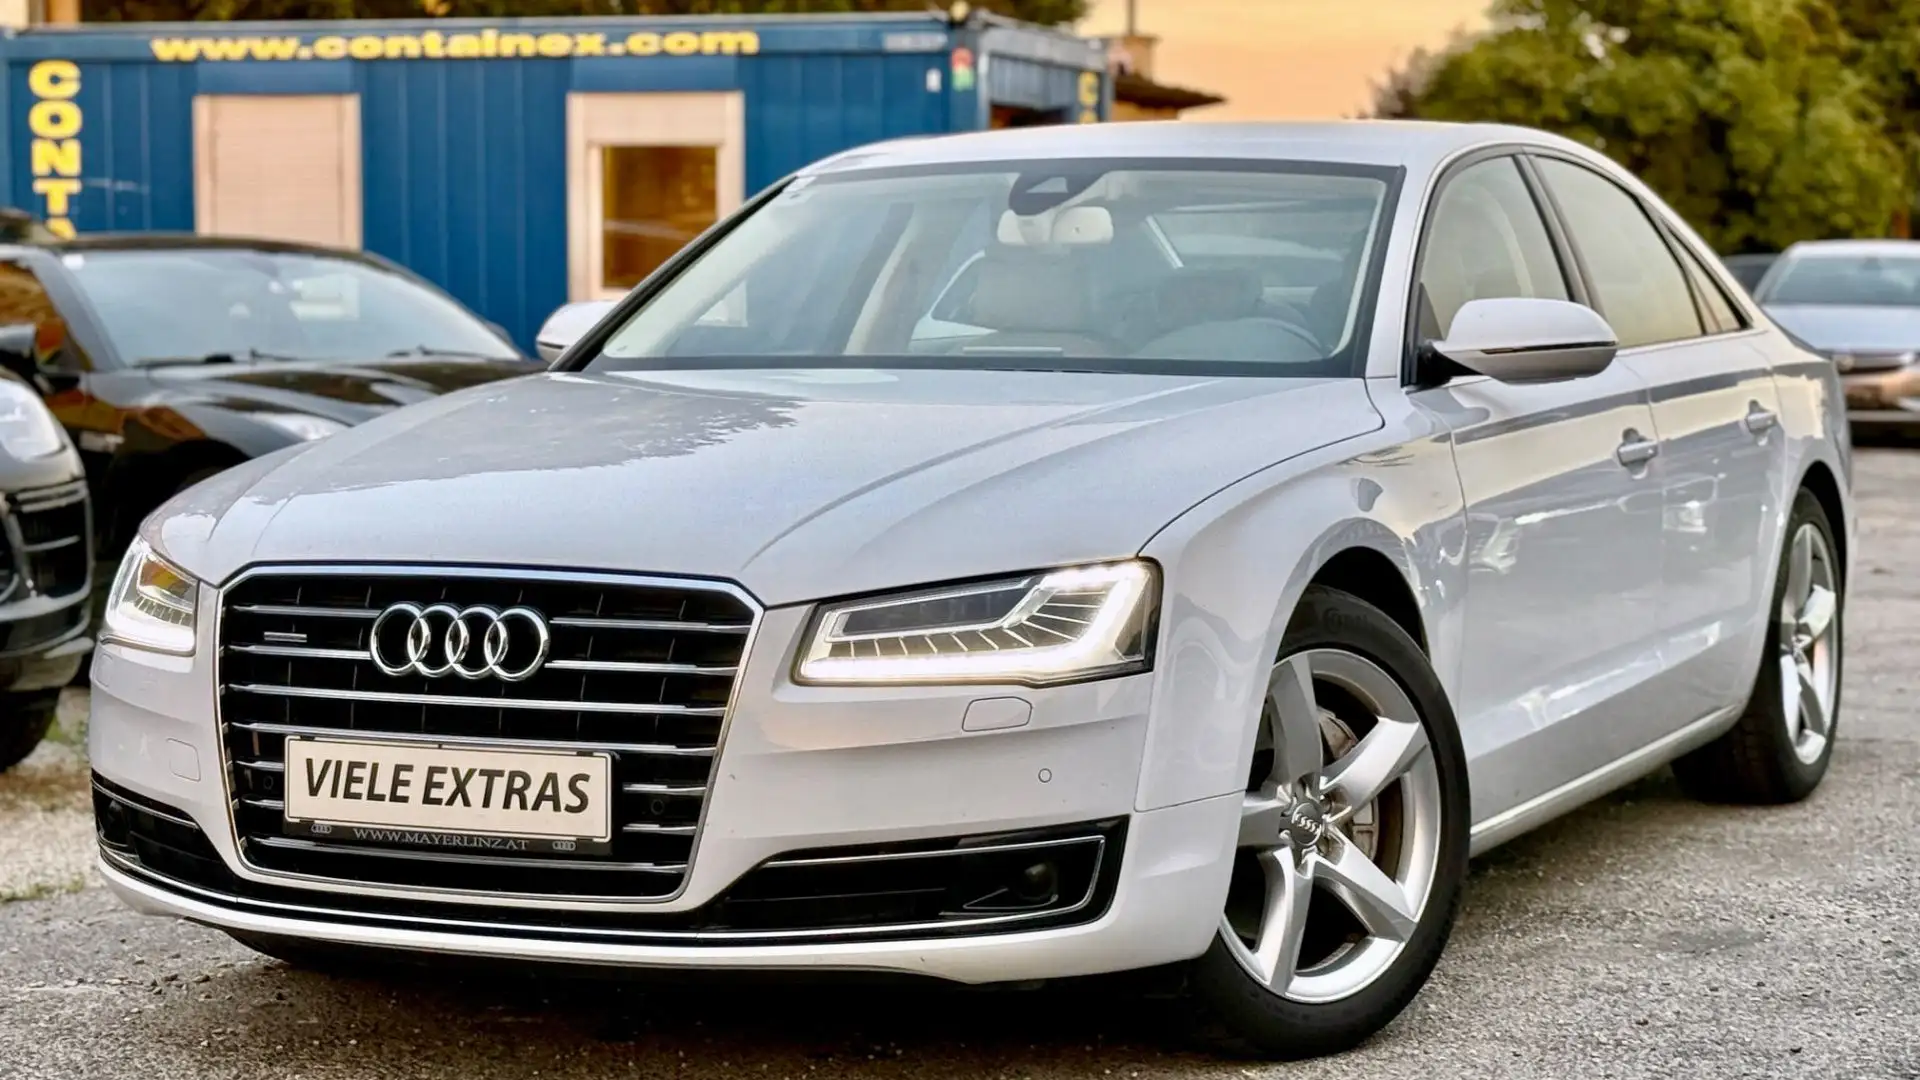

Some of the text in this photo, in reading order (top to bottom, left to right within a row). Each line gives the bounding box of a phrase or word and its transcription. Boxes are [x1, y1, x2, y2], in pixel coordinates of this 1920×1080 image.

[151, 29, 760, 62] www.containex.com
[305, 758, 591, 814] VIELE EXTRAS
[353, 827, 530, 850] WWW.MAYERLINZ.AT
